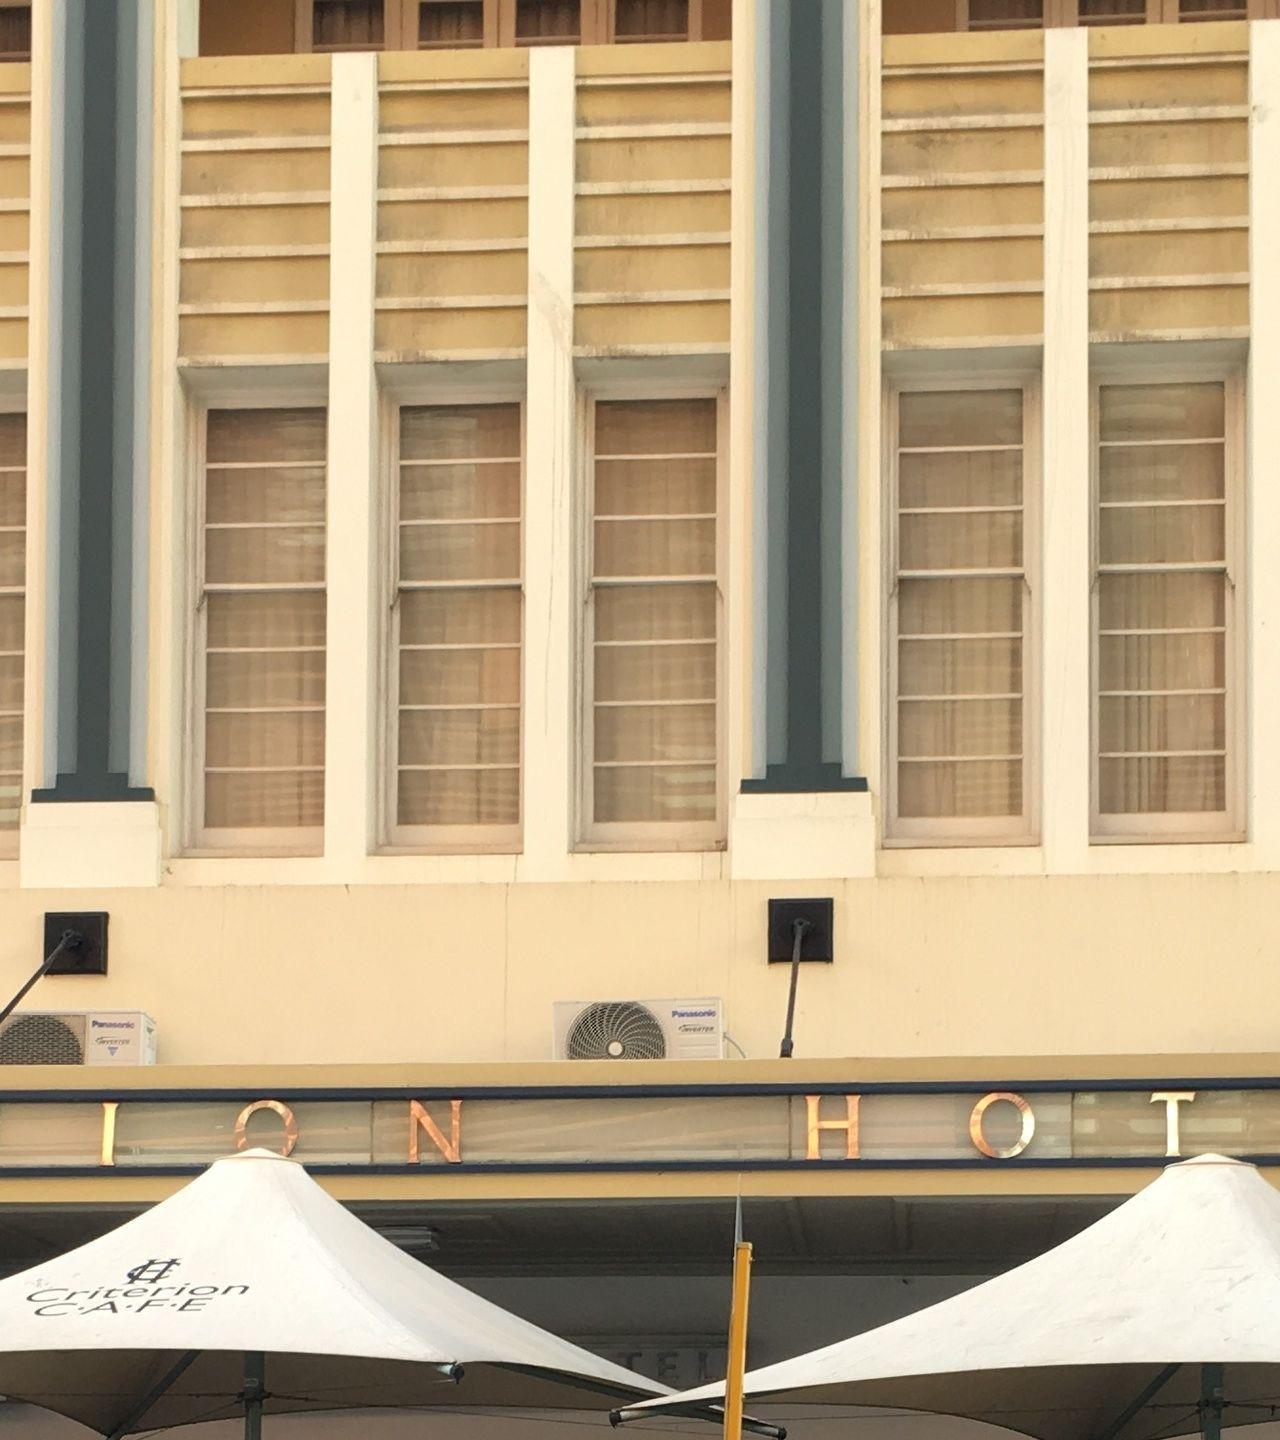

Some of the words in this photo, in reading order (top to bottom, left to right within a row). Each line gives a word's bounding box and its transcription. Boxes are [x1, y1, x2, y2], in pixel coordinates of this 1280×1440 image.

[671, 1009, 717, 1018] Panasonic
[91, 1020, 136, 1029] Panasonic
[26, 1283, 251, 1303] Criterion
